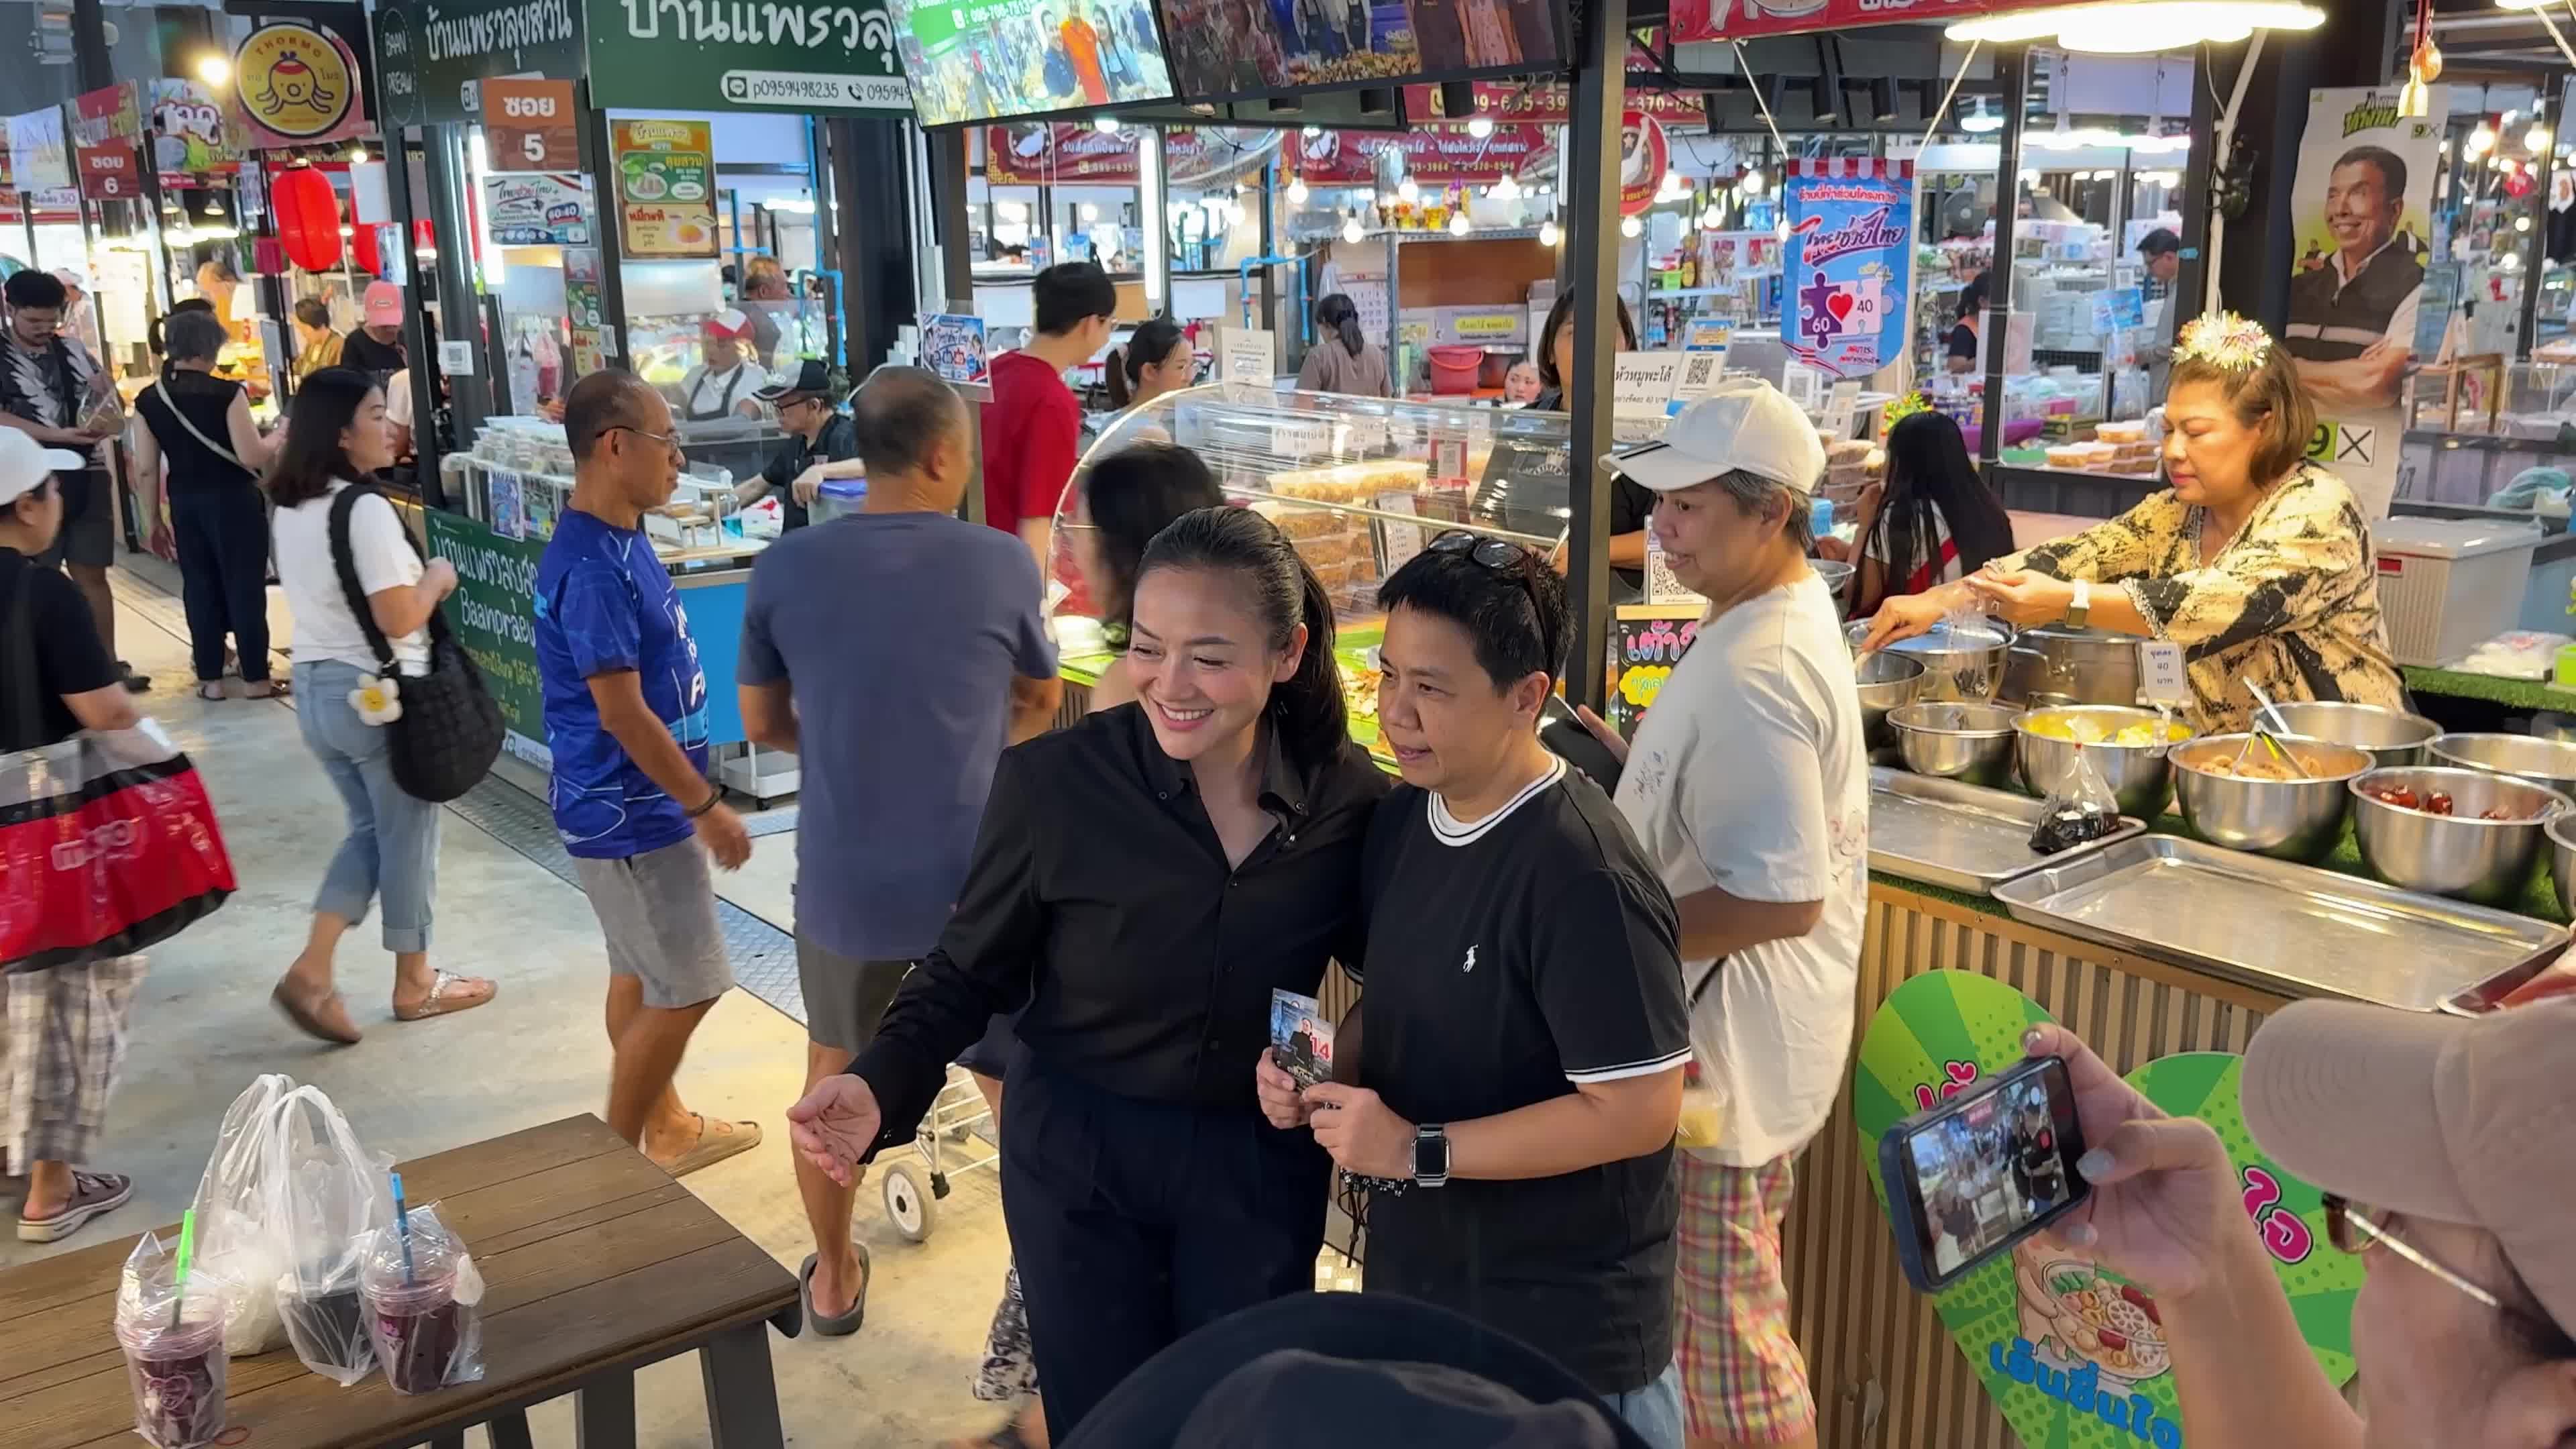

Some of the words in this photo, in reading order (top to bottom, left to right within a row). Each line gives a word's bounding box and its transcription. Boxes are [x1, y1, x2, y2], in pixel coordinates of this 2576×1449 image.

[621, 0, 894, 73] บานแพรวลุ
[255, 36, 322, 58] THORMO
[753, 80, 839, 99] p0959498235
[504, 97, 556, 117] ซอย
[523, 133, 545, 162] 5
[90, 156, 124, 169] ซอย
[104, 176, 119, 195] 6
[1857, 299, 1873, 313] 40
[1813, 317, 1830, 333] 60
[1615, 365, 1674, 388] หัวหมูพะโล้
[1309, 1036, 1330, 1061] 14
